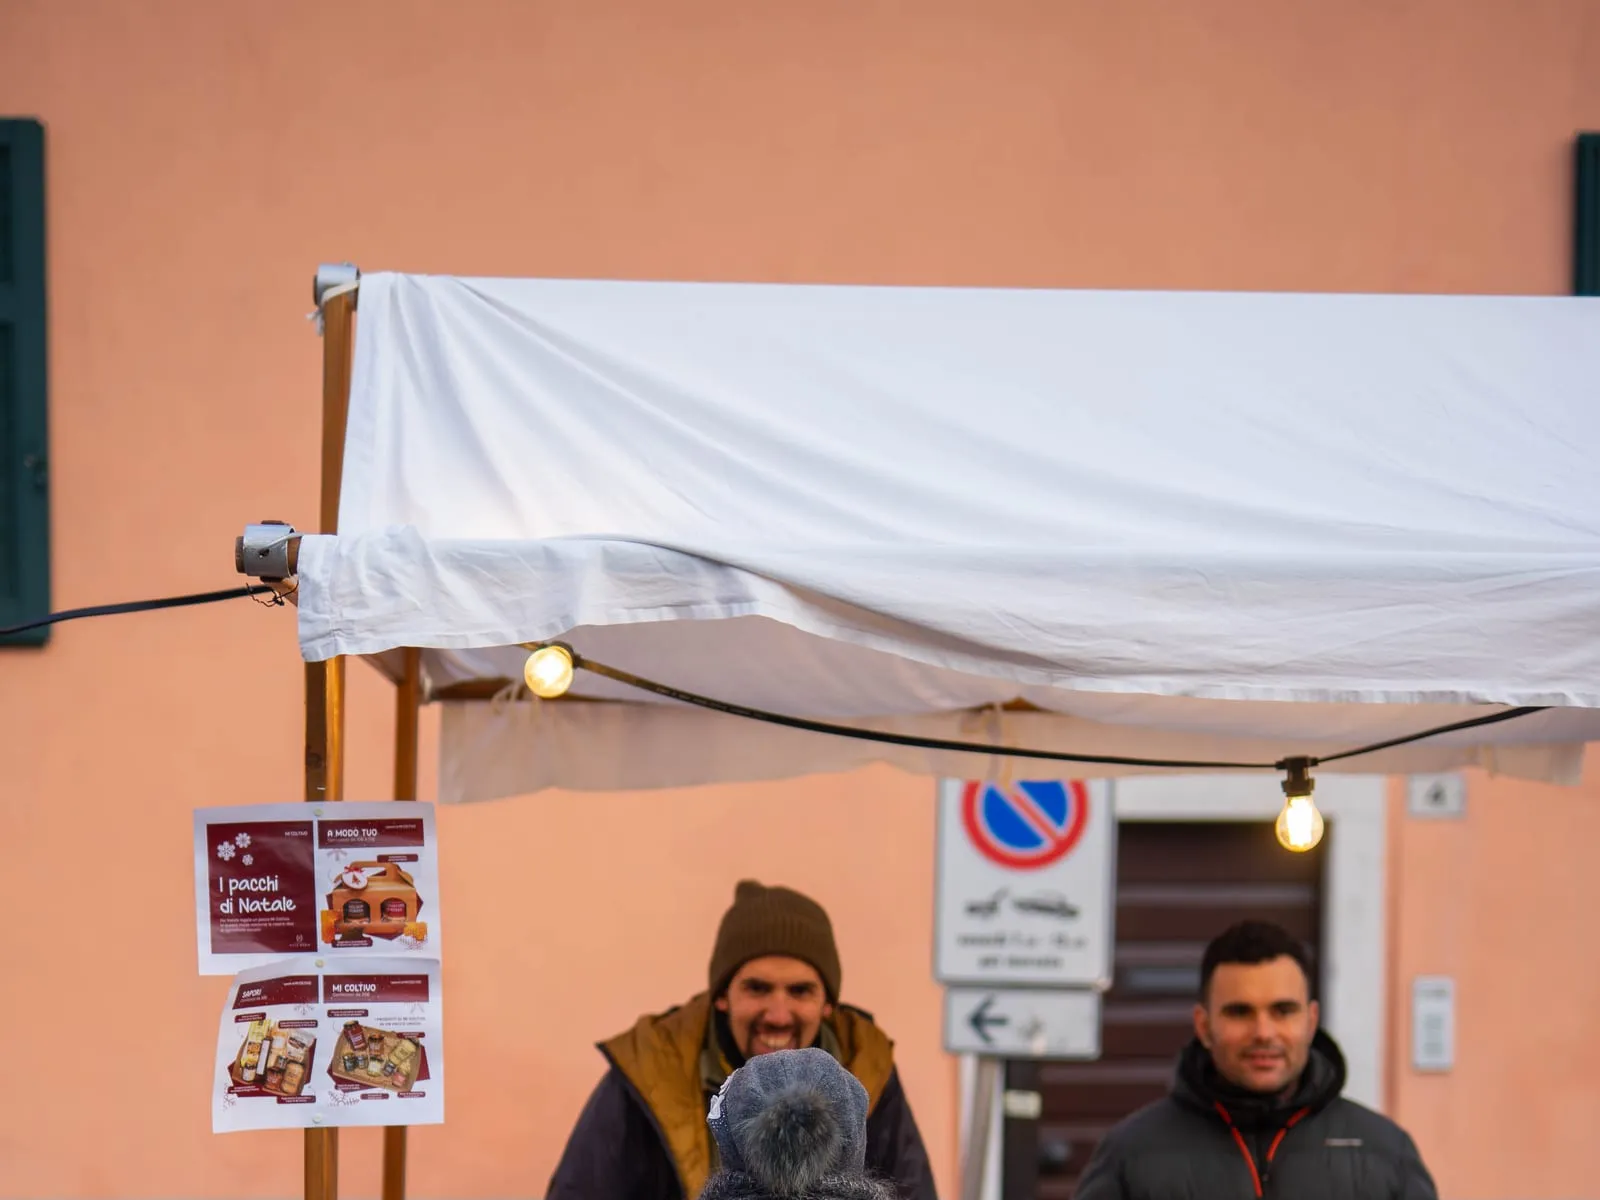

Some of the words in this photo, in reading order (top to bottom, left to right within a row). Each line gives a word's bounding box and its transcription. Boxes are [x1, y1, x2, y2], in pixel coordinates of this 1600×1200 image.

[327, 829, 333, 837] A
[335, 829, 359, 837] MODO
[361, 828, 377, 837] TUO
[218, 876, 224, 893] I
[228, 874, 279, 895] pacchi
[219, 897, 234, 914] di
[238, 895, 296, 914] Natale
[332, 983, 341, 992] MI
[344, 983, 377, 992] COLTIVO
